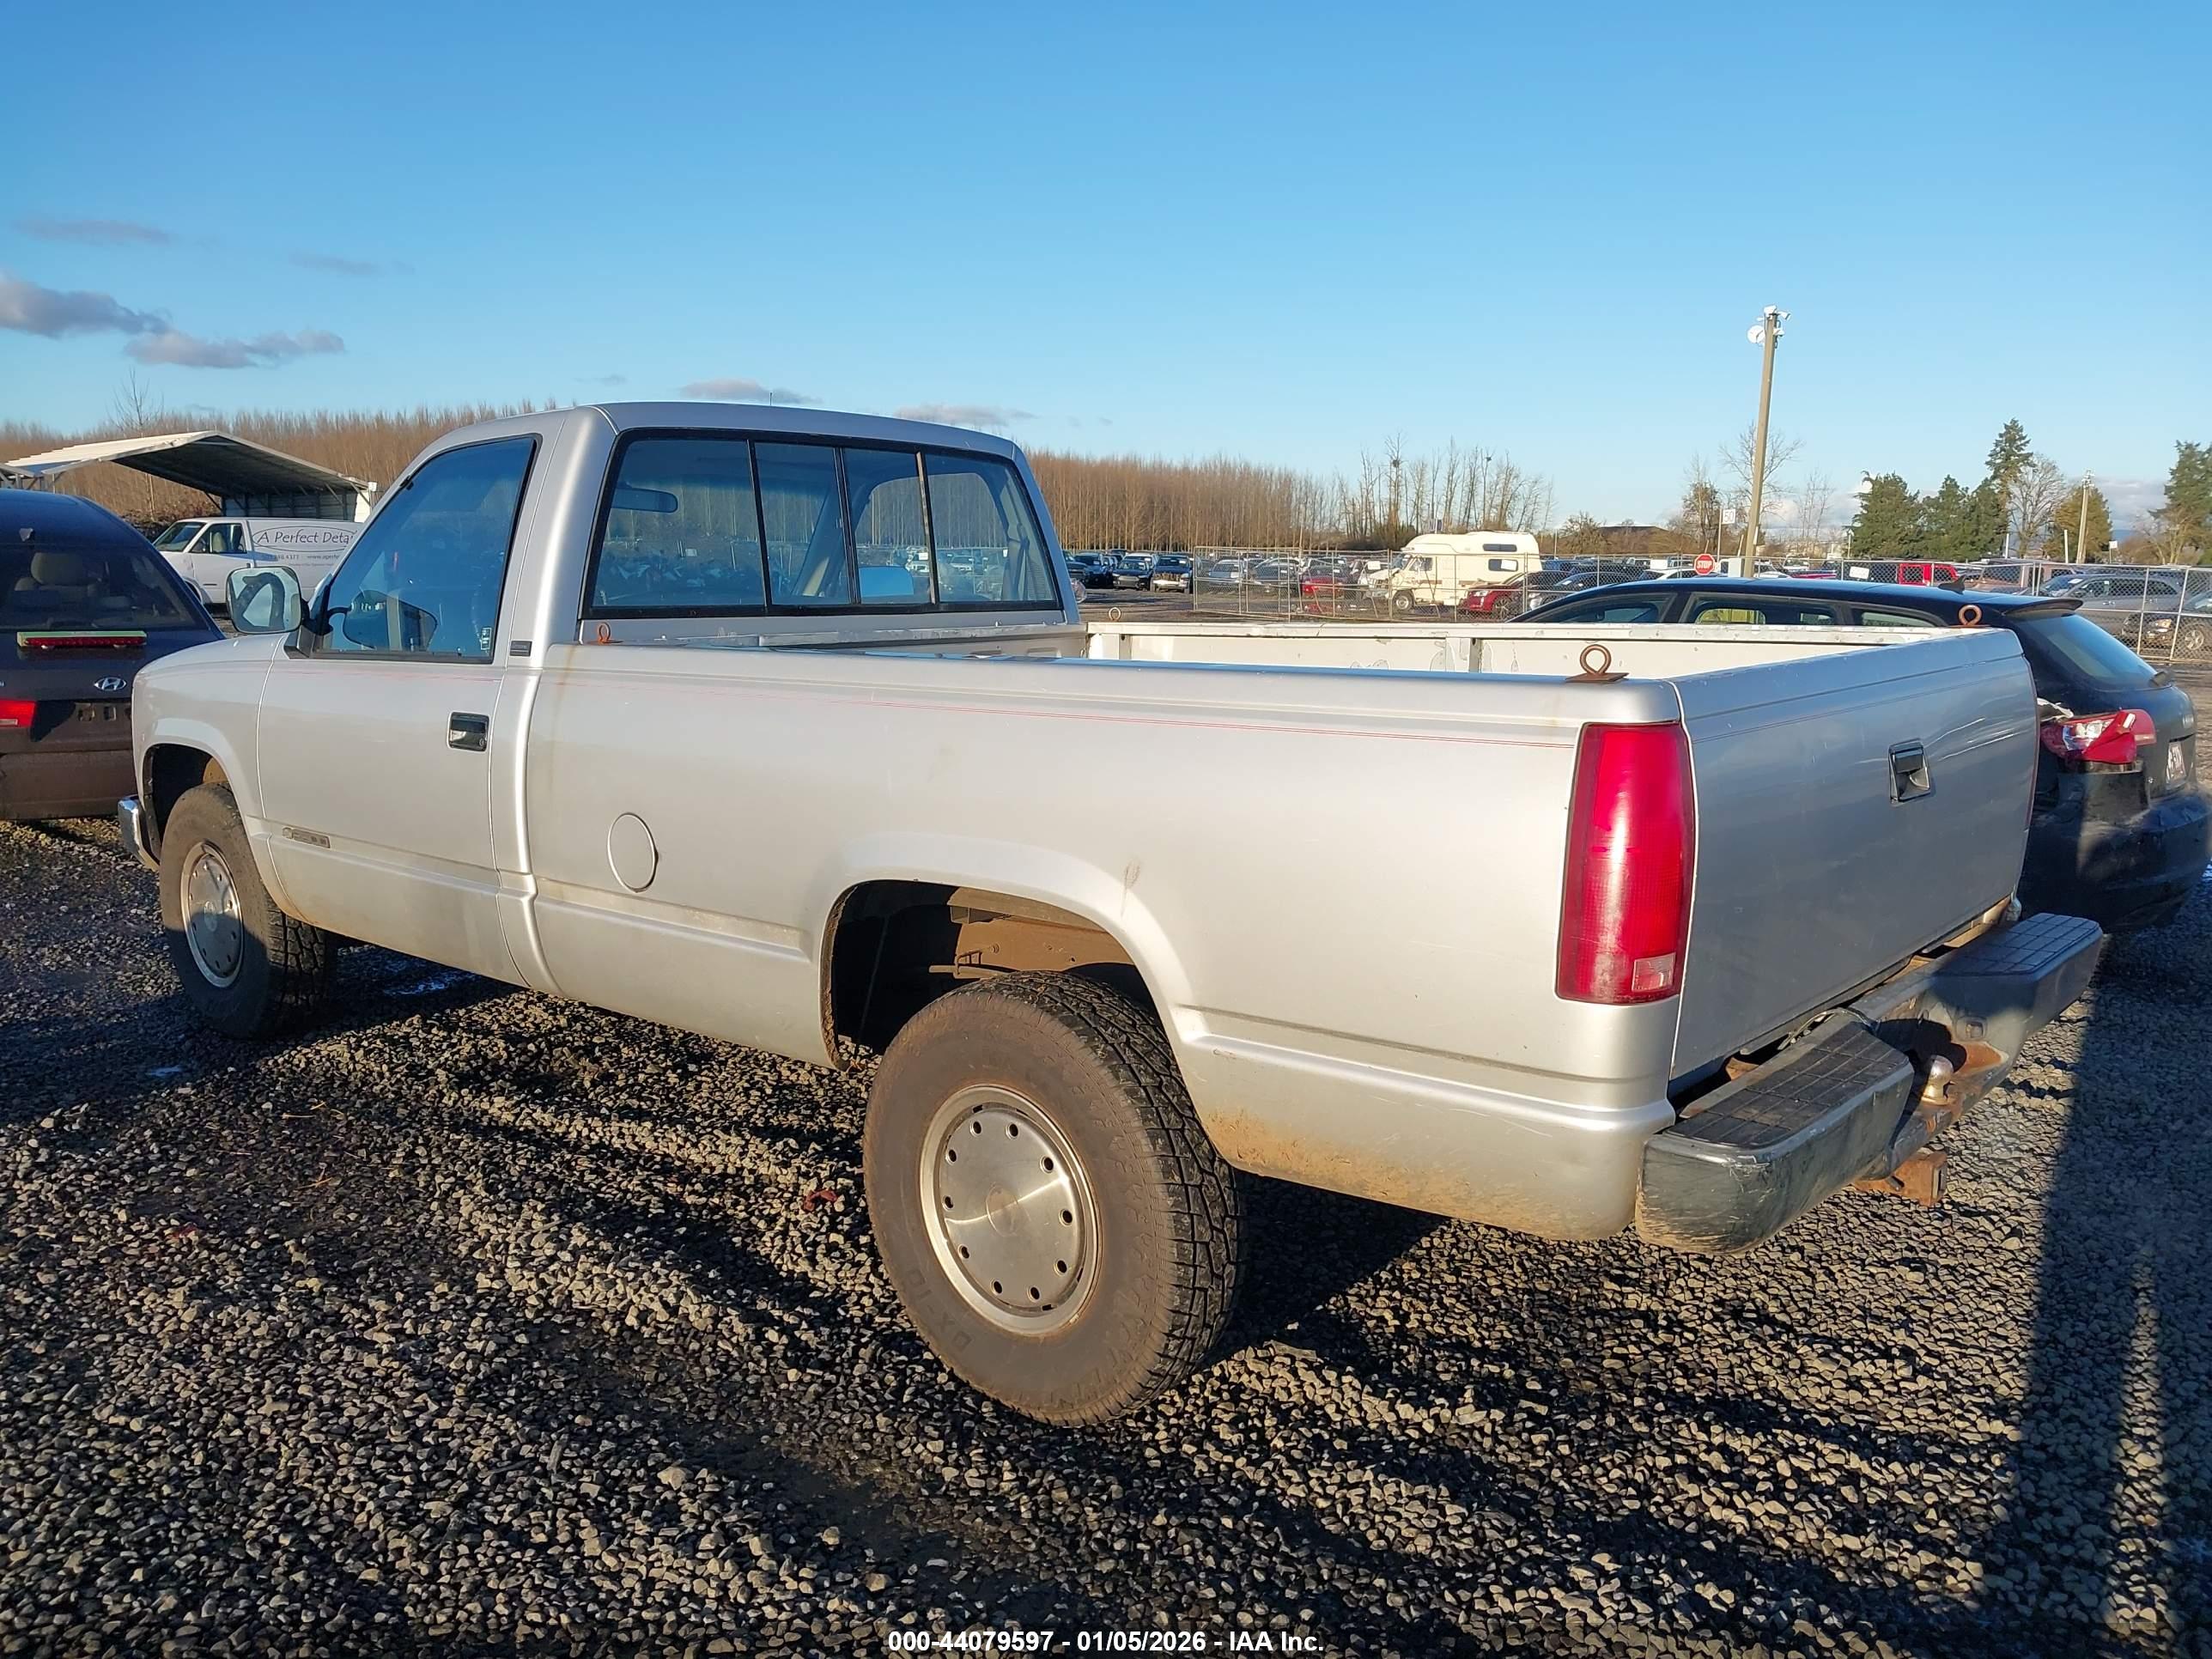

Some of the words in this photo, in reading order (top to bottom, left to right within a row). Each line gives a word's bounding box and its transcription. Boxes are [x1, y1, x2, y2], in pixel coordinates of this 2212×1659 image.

[257, 532, 270, 544] A
[274, 528, 319, 544] Perfect
[1696, 560, 1713, 569] STOP
